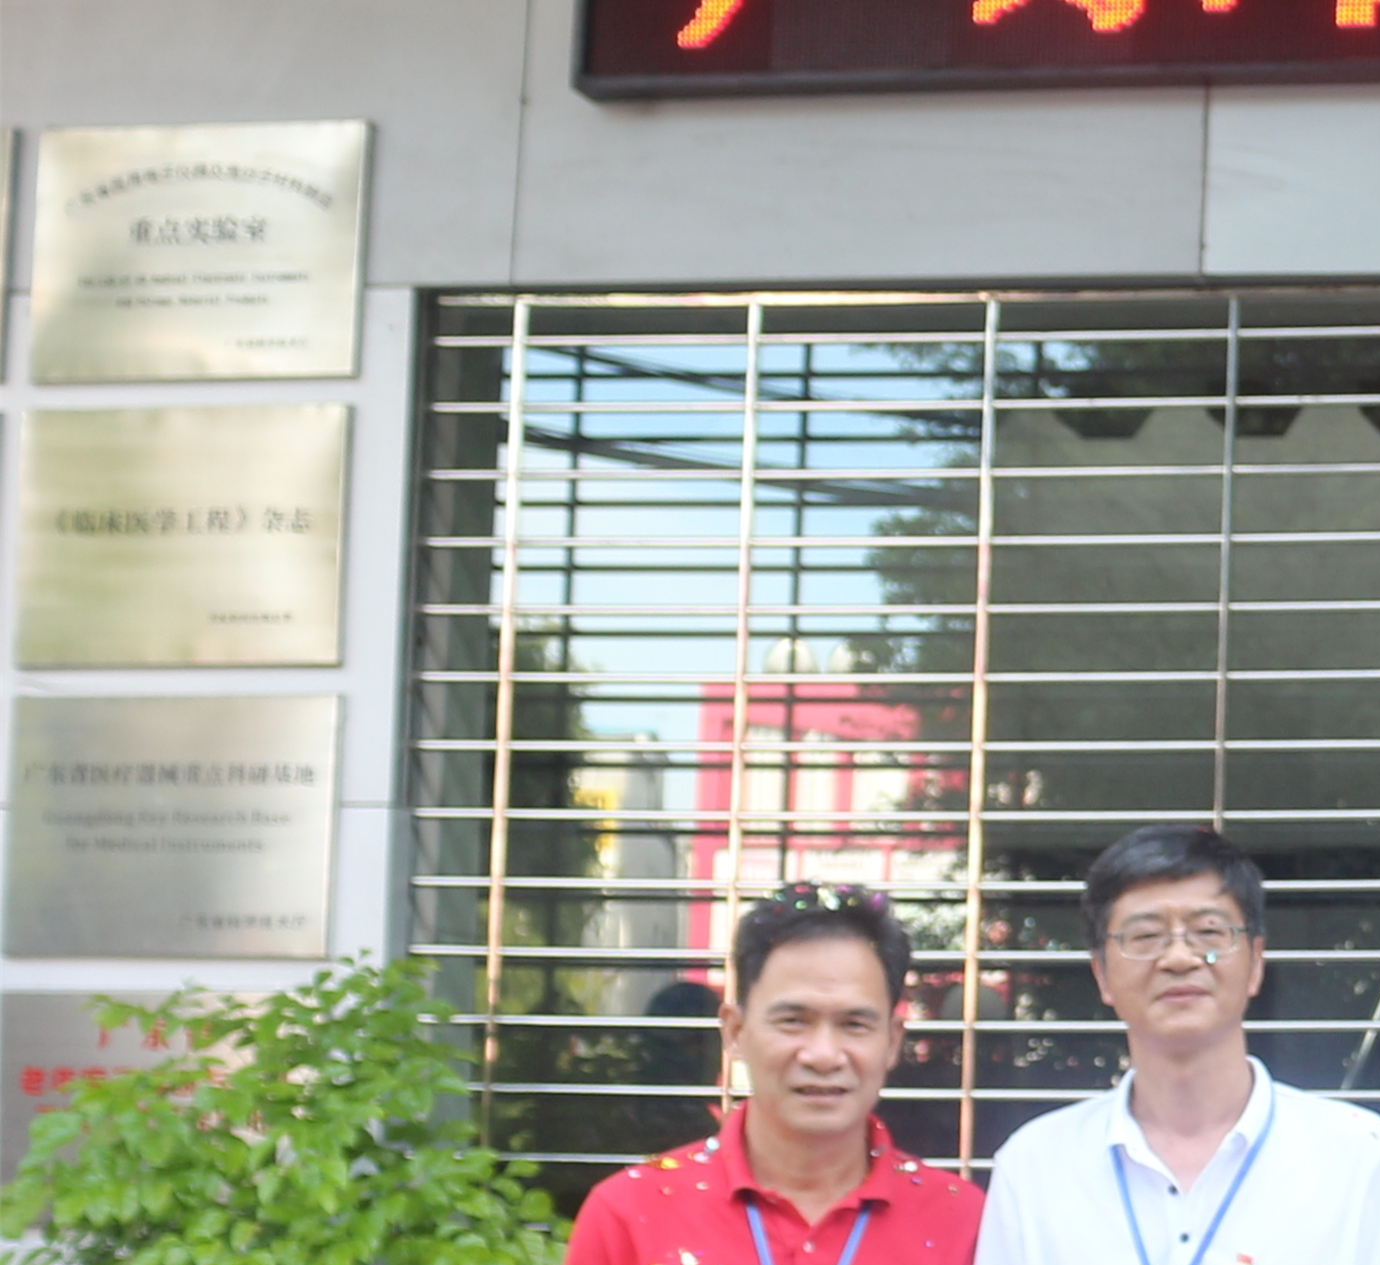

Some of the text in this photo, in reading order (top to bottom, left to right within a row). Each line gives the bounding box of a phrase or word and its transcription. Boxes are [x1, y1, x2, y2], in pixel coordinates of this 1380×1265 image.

[130, 215, 269, 245] 重点实验室
